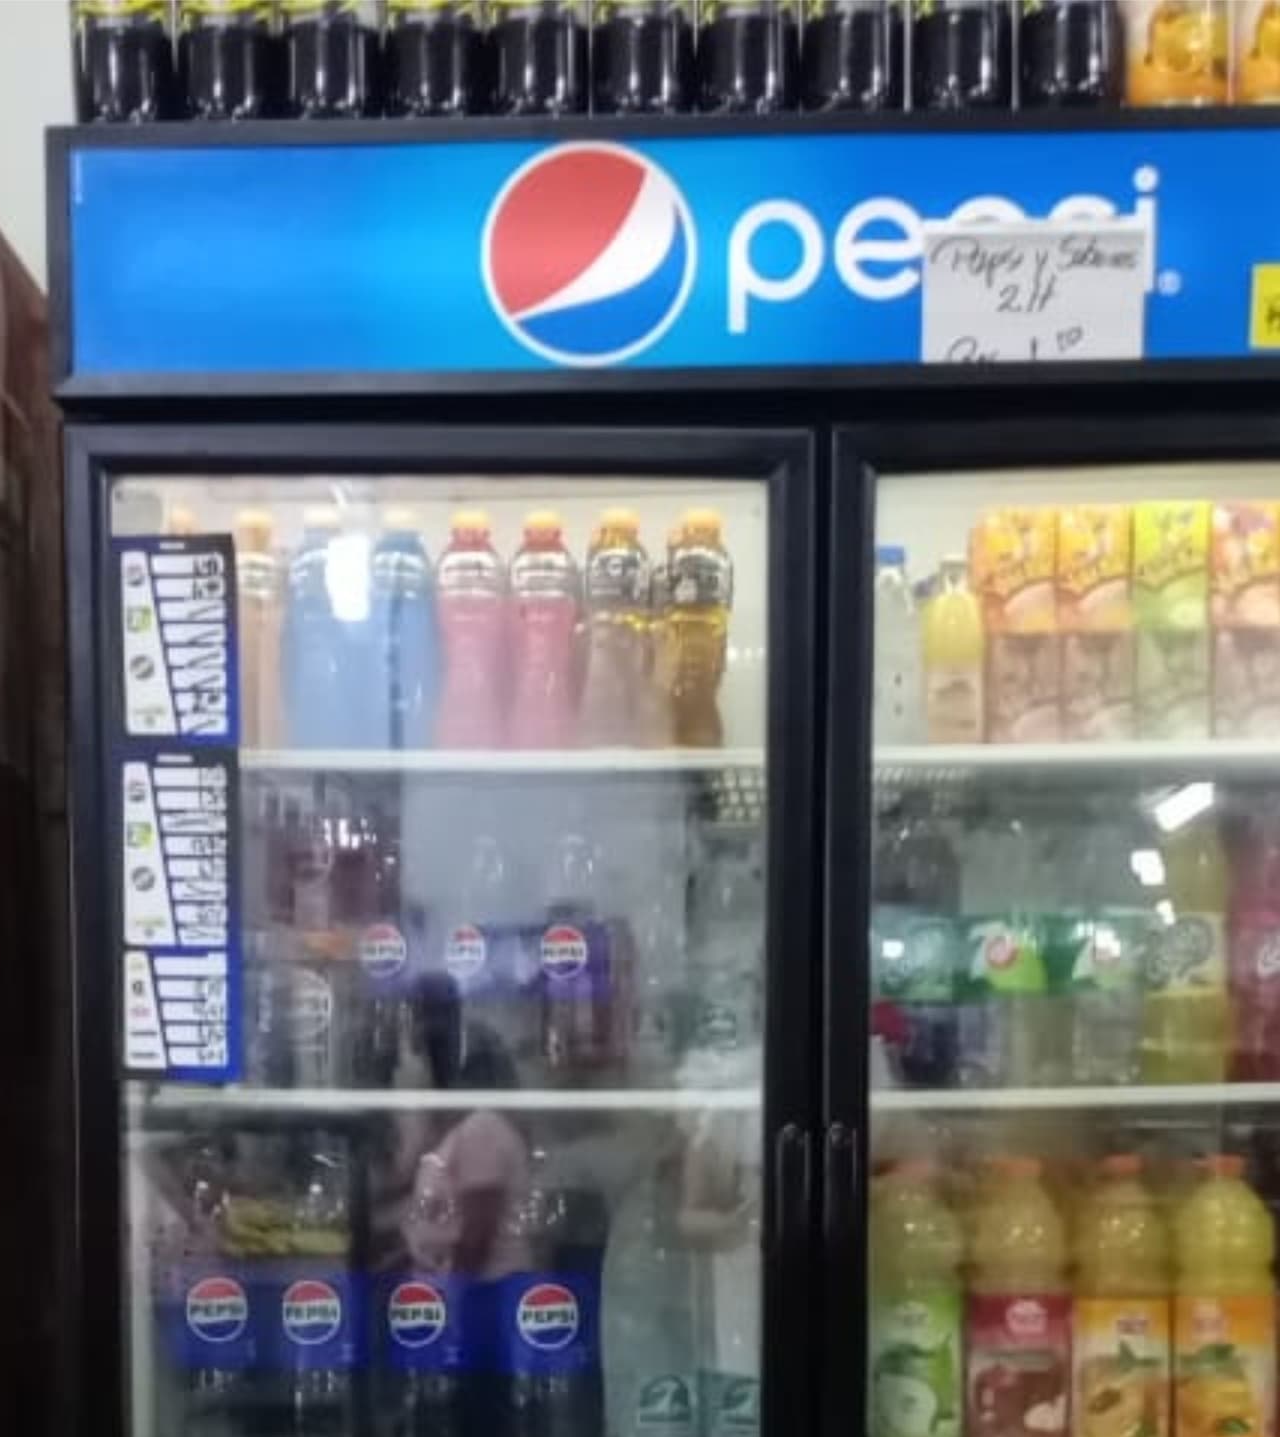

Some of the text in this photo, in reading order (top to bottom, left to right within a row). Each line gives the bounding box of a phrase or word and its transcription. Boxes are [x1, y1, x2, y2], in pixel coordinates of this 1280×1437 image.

[728, 166, 1160, 333] pei
[189, 1303, 244, 1320] PEPSI
[284, 1305, 339, 1322] PEPSI
[390, 1307, 441, 1323] PEPSI
[521, 1309, 576, 1325] PEPSI
